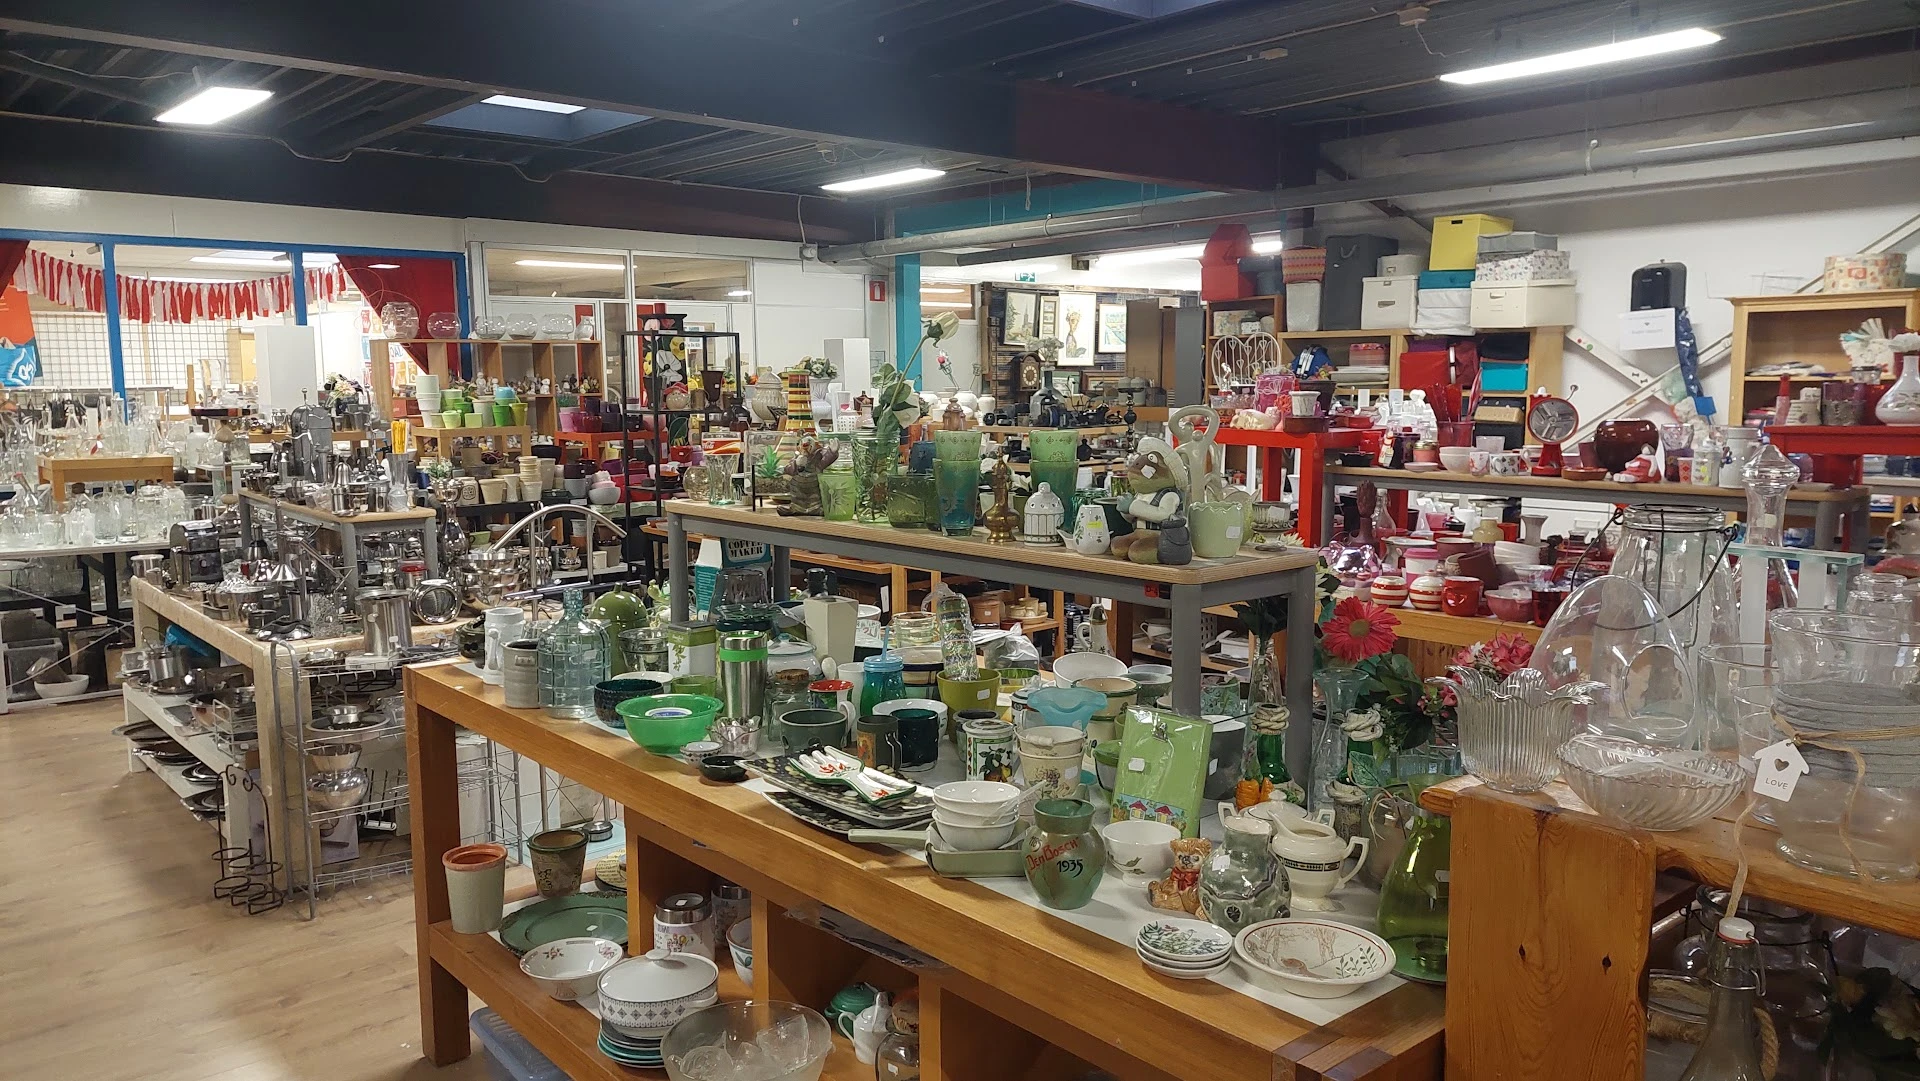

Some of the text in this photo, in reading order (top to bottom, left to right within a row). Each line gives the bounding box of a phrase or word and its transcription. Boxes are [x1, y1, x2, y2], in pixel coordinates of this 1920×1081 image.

[730, 547, 763, 557] MAKER
[1765, 777, 1789, 790] LOVE
[1056, 859, 1084, 878] 1935
